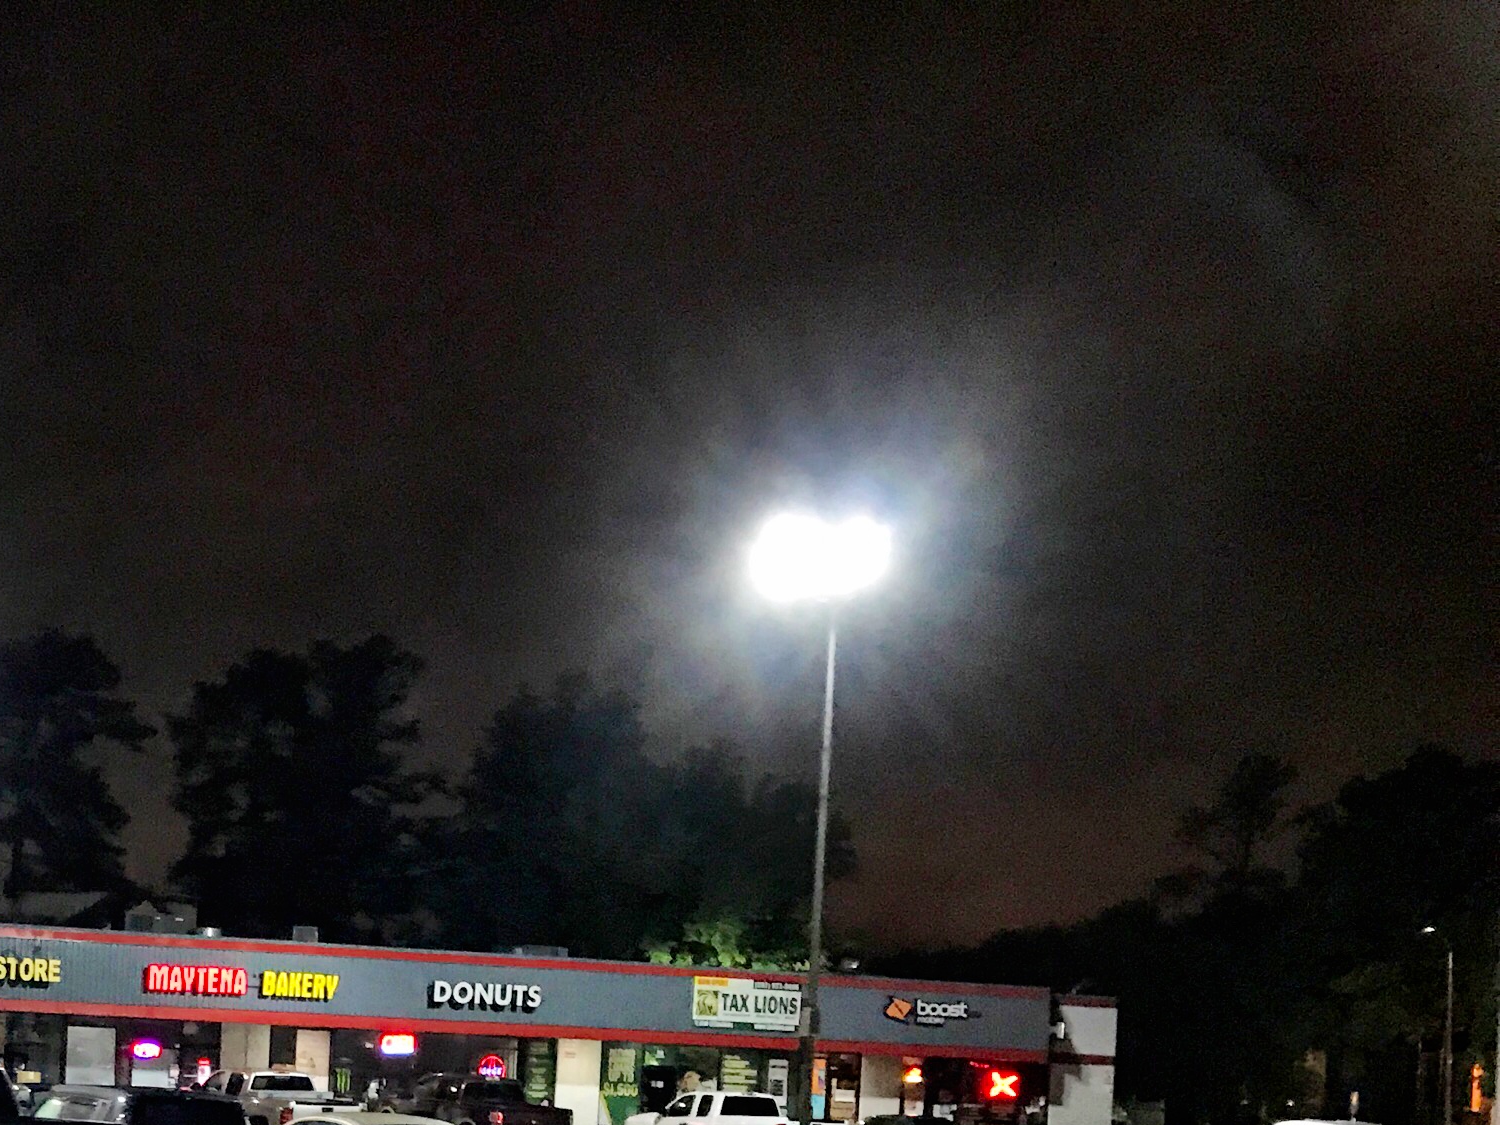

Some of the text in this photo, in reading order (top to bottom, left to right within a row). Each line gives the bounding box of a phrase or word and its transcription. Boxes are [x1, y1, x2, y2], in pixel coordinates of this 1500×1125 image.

[148, 964, 339, 999] MAYTENA BAKERY
[433, 980, 542, 1008] DONUTS
[722, 993, 798, 1015] TAX LIONS
[916, 999, 968, 1018] boost
